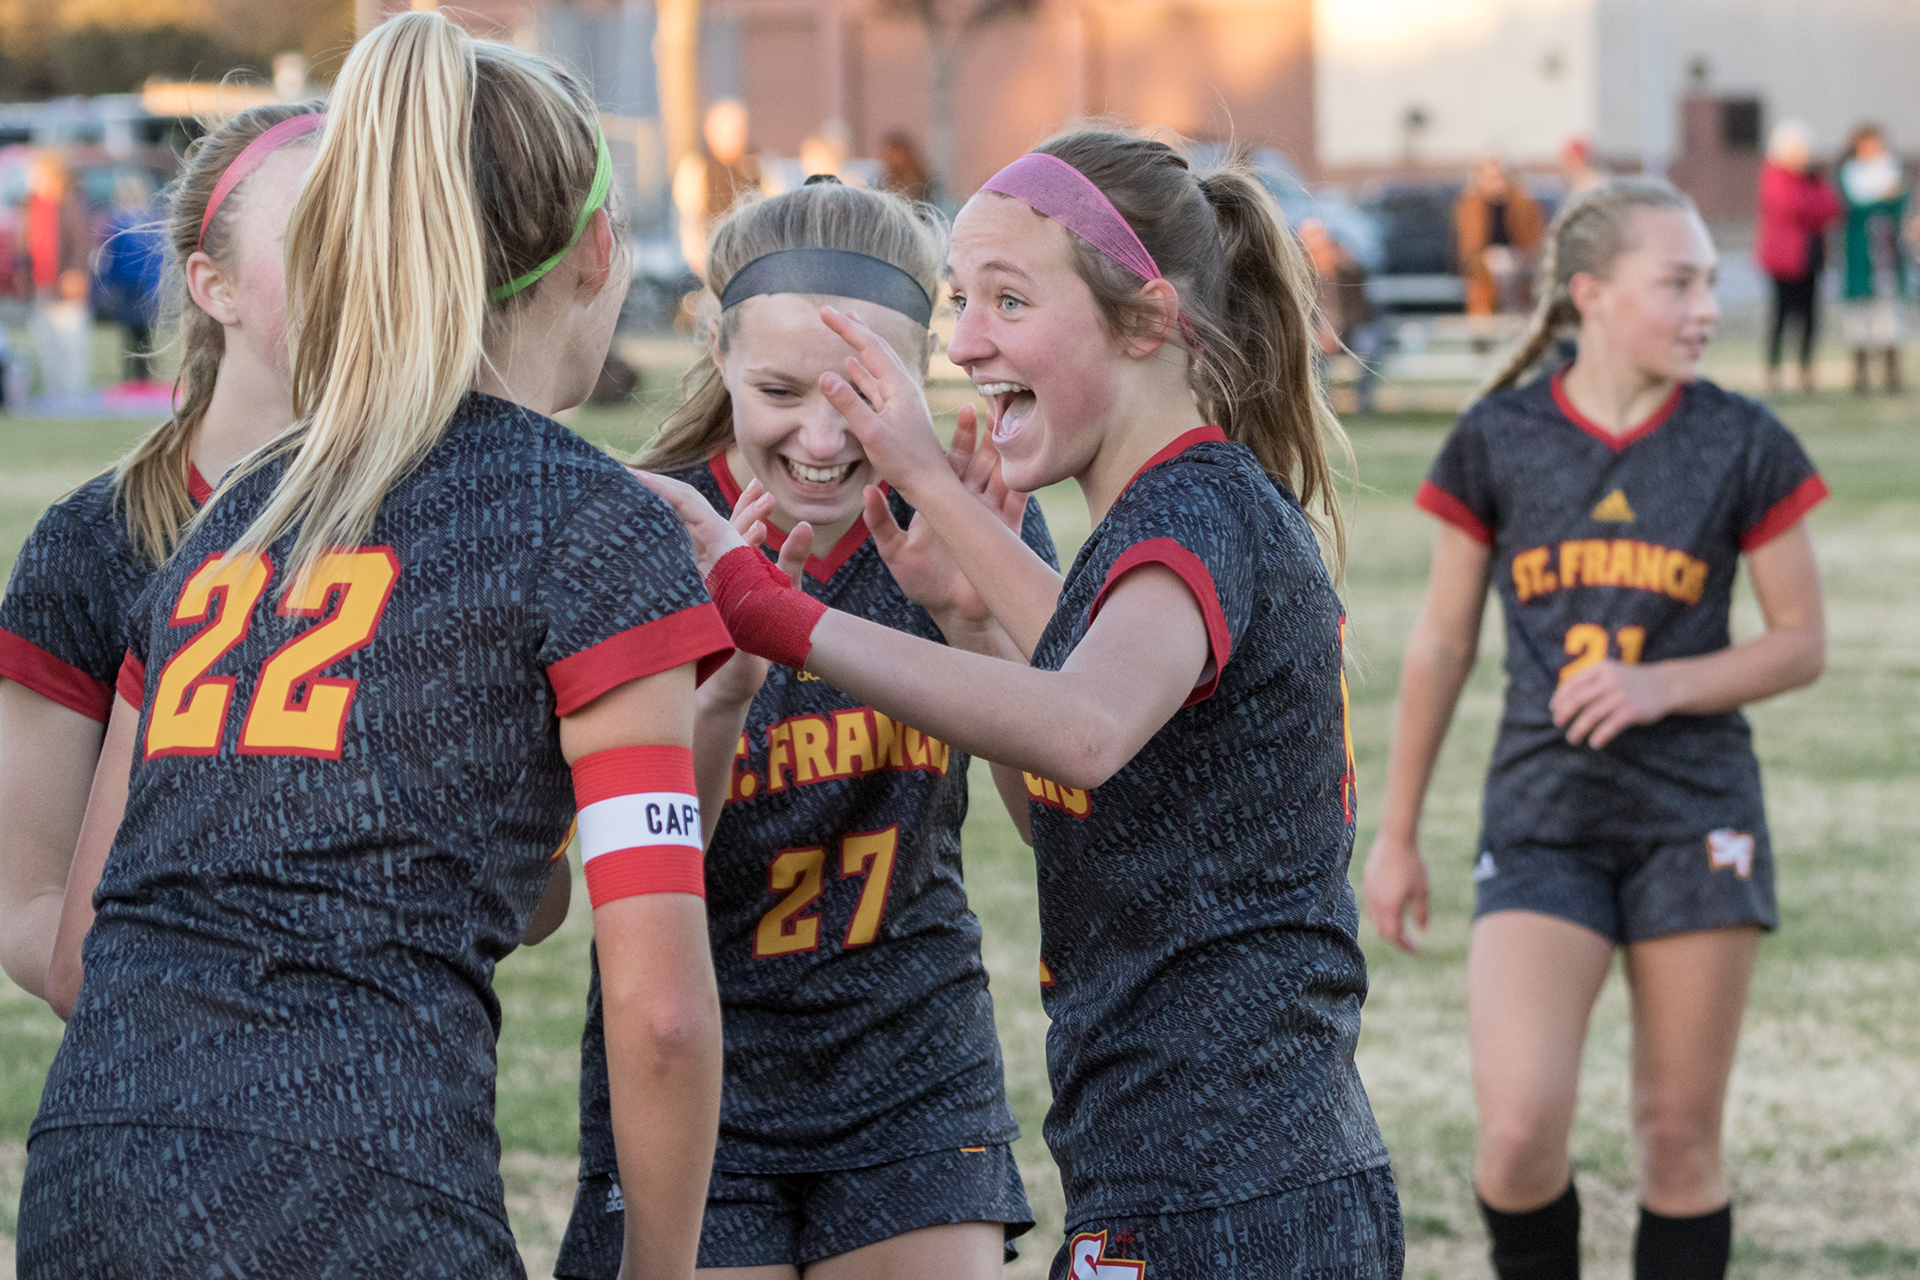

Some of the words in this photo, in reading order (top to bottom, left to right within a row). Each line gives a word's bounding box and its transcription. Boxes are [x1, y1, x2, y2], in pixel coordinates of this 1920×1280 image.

[143, 545, 400, 763] 22
[766, 706, 949, 788] FRANCI
[752, 822, 899, 959] 27
